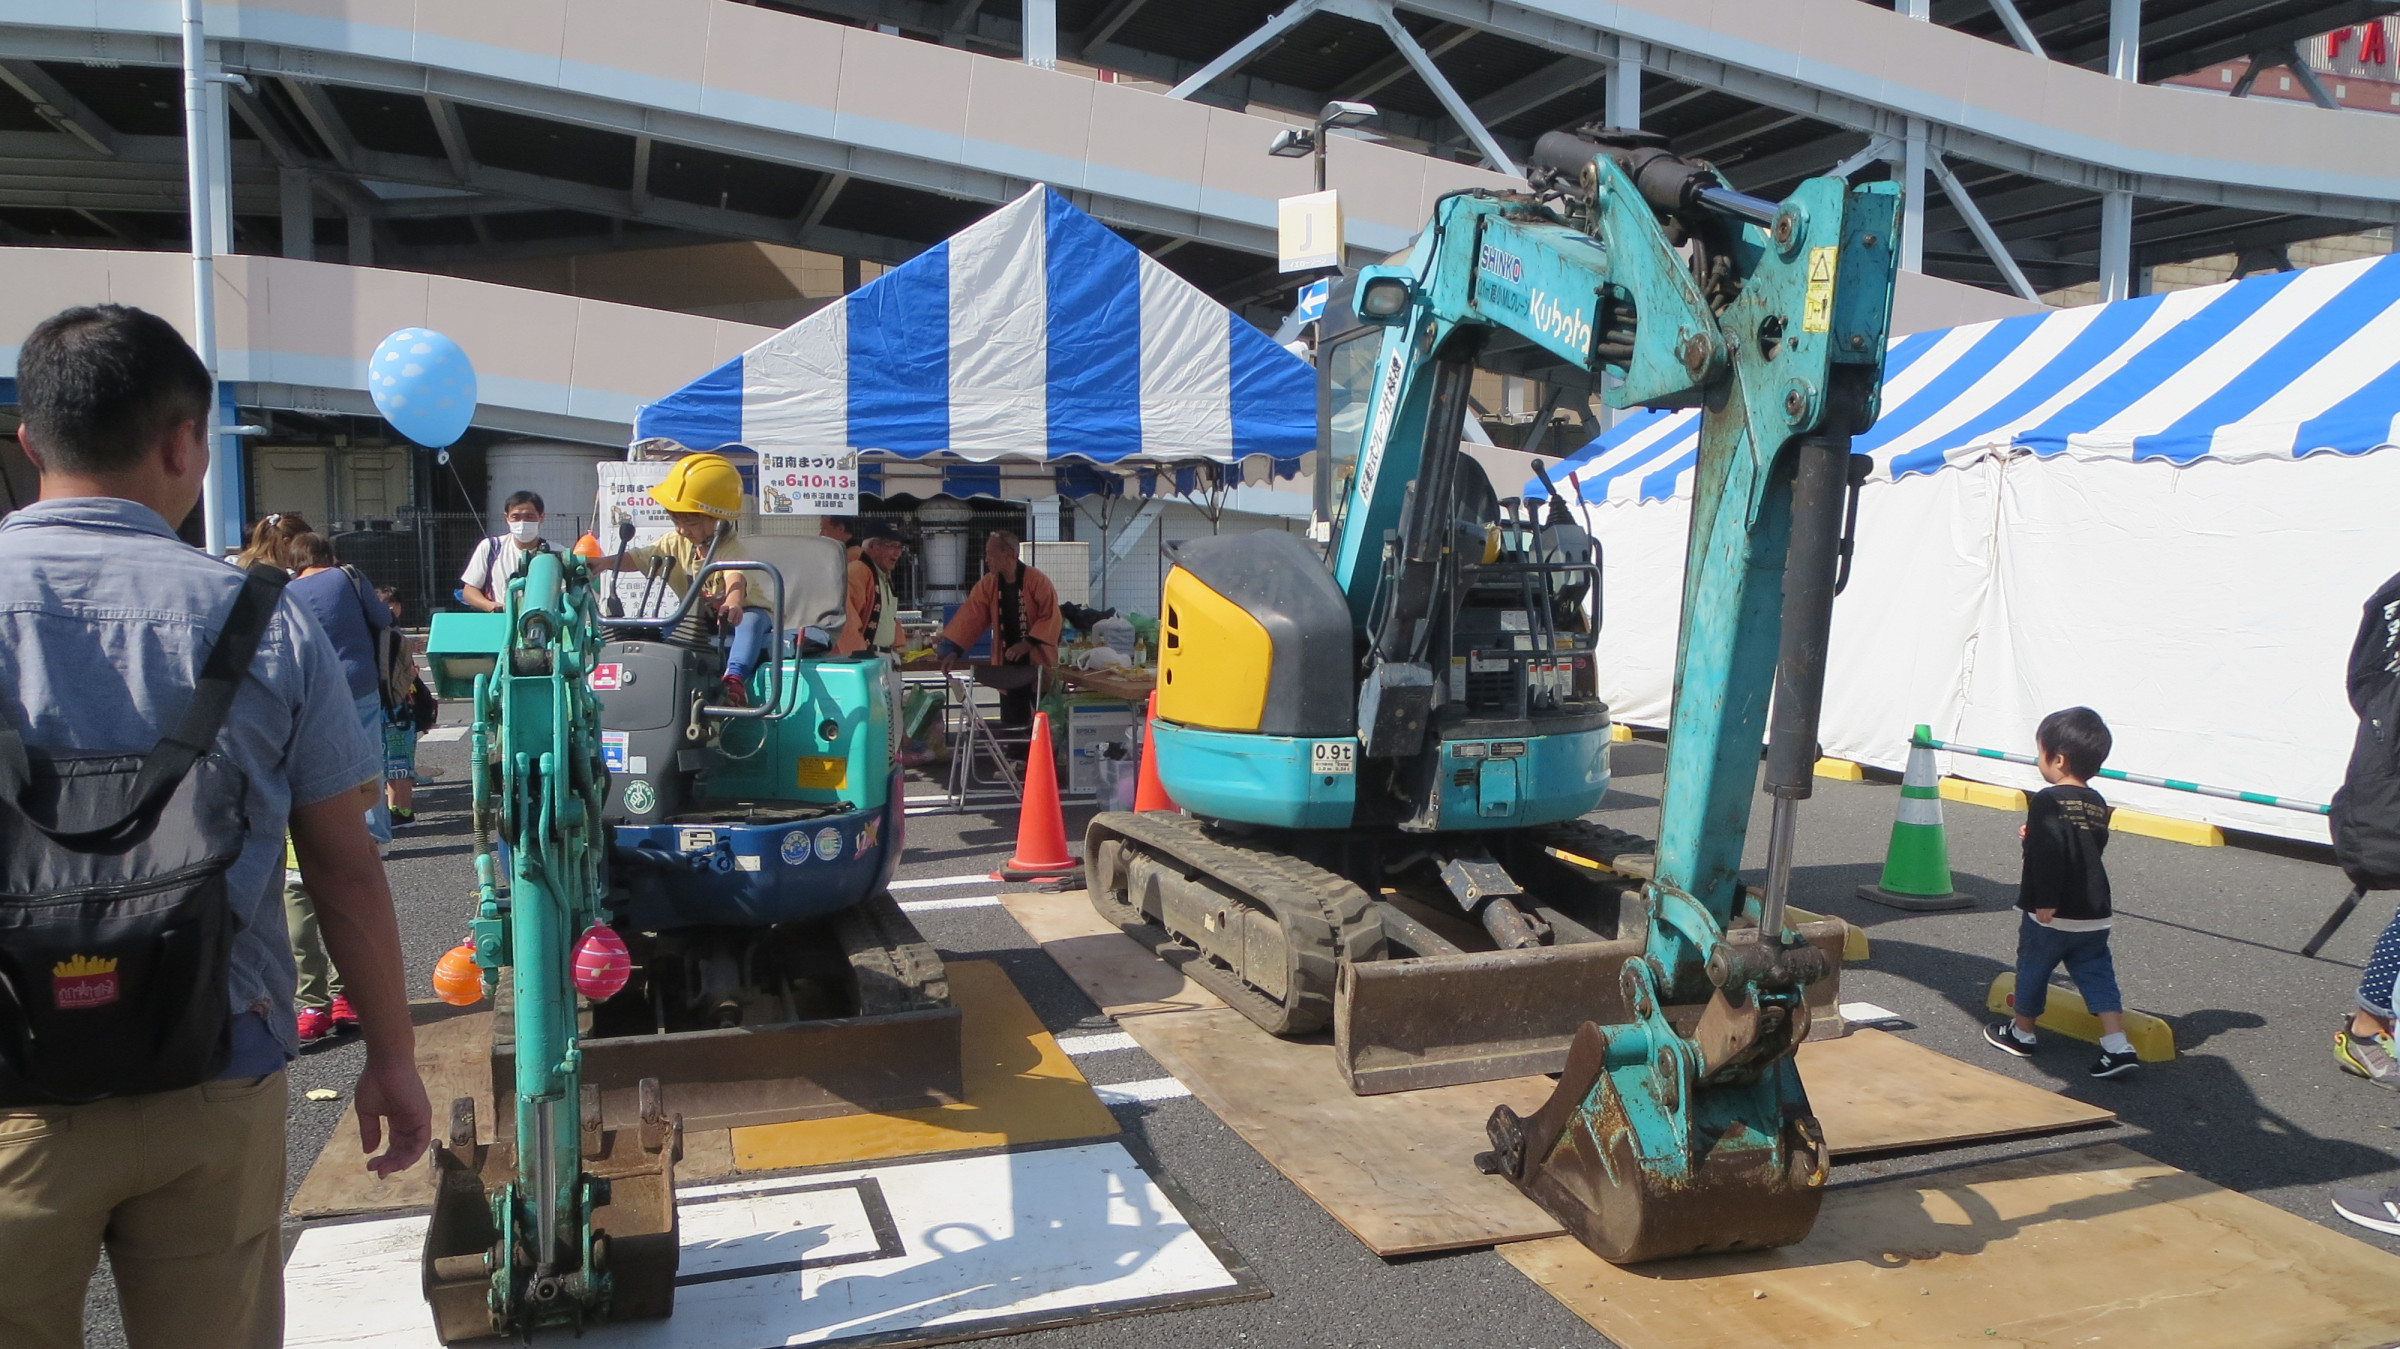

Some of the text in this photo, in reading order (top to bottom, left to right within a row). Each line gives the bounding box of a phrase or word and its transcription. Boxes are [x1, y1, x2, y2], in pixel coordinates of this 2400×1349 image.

[1299, 212, 1313, 252] J
[1290, 257, 1327, 268] イエローゾーン
[1481, 244, 1522, 284] SHINKO
[1529, 288, 1591, 355] Kubota
[772, 456, 836, 469] 沼南まつり
[771, 474, 856, 488] 令和6年10月13日
[803, 492, 855, 500] 柏市沼南商工会
[1315, 744, 1351, 760] 0.9t
